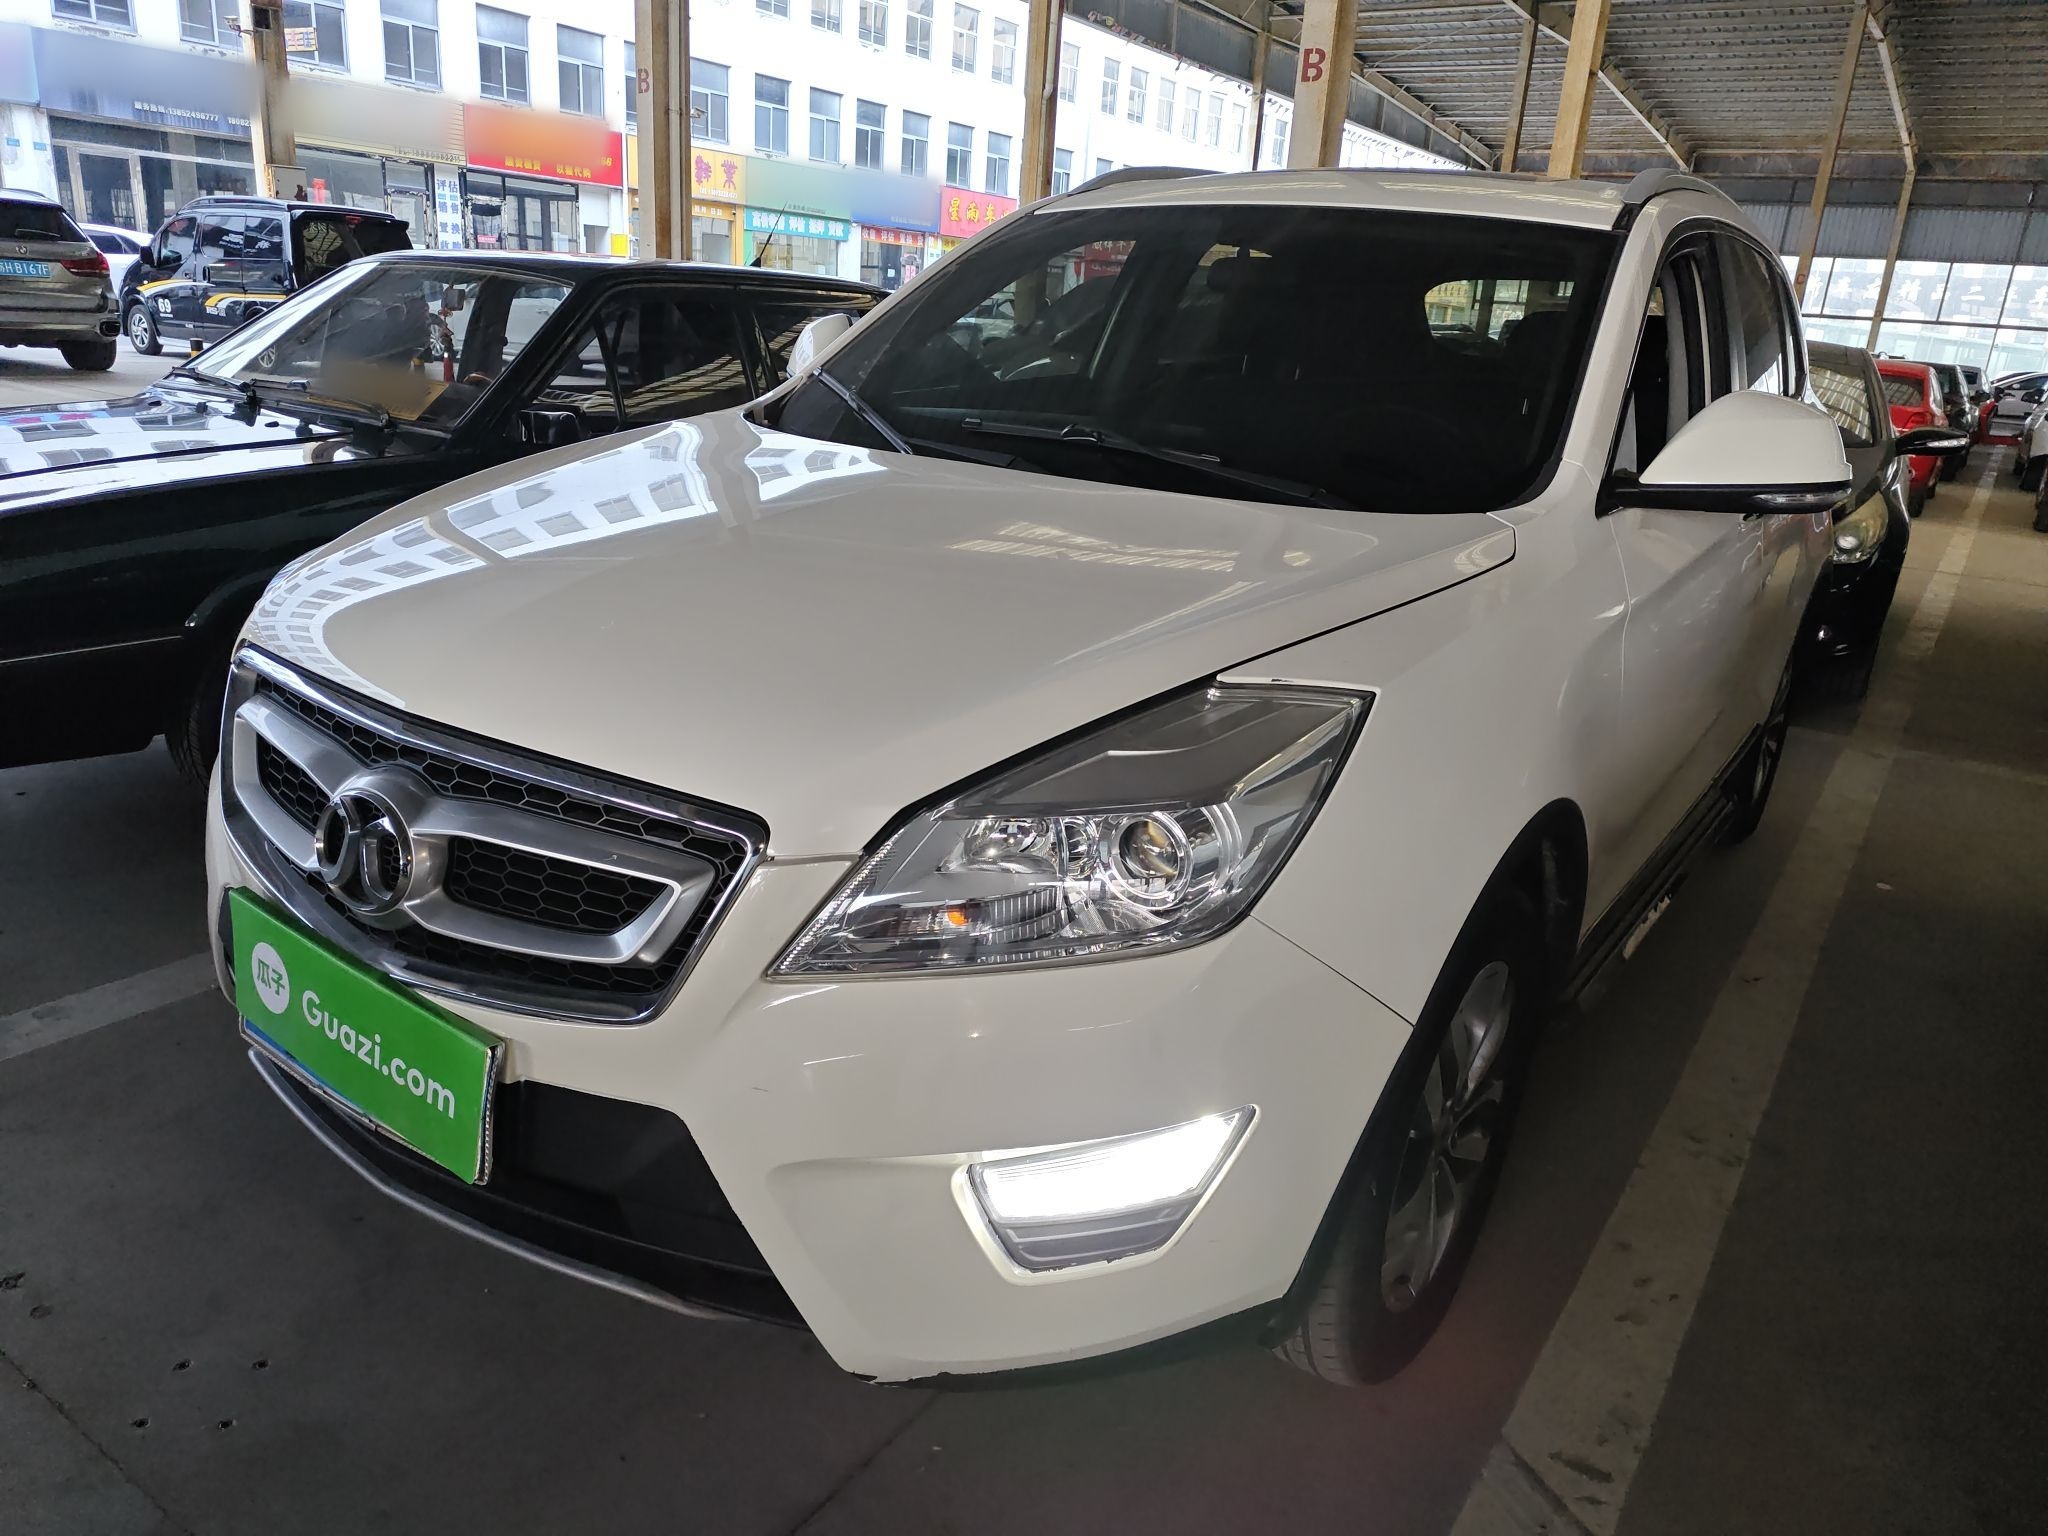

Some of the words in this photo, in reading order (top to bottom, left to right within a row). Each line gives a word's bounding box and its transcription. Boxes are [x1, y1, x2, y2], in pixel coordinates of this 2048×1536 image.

[1300, 47, 1326, 82] B
[637, 67, 650, 94] B
[437, 179, 459, 193] 评估
[158, 298, 171, 313] 69
[256, 957, 287, 997] 瓜子
[302, 989, 456, 1119] Guazi.com
